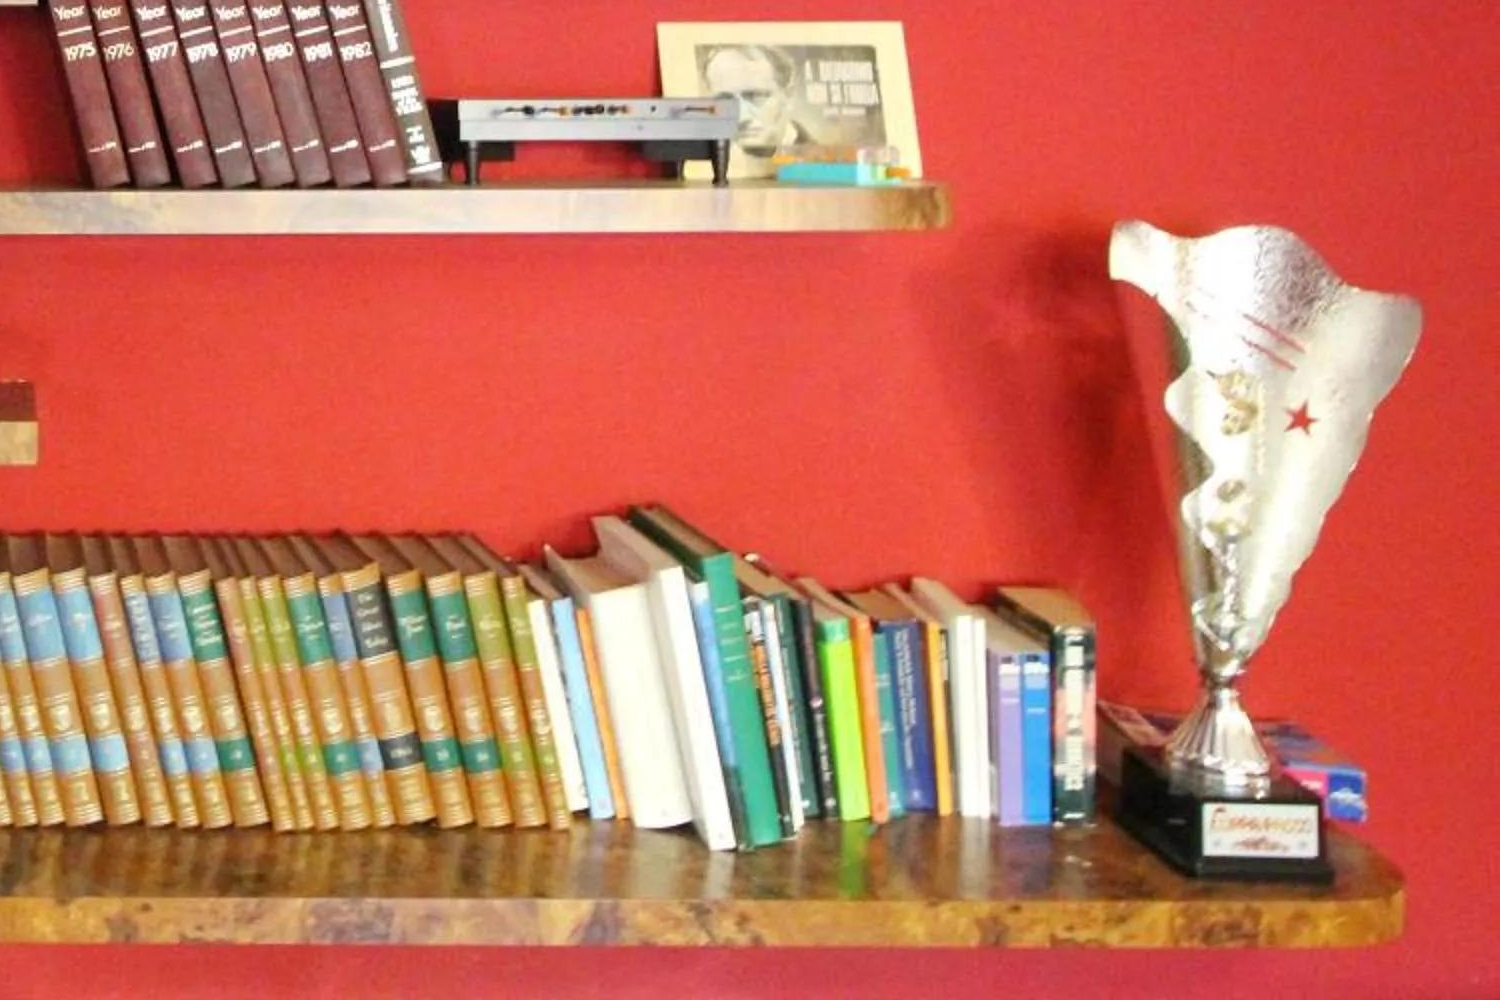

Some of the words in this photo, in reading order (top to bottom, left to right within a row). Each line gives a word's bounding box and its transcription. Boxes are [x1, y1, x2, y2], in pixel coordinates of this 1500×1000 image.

[54, 5, 85, 21] Year
[93, 5, 123, 20] Year
[137, 5, 167, 21] Year
[175, 5, 206, 23] Year
[215, 5, 246, 21] Year
[252, 4, 283, 20] Year
[291, 5, 321, 21] Year
[329, 4, 360, 20] Year
[65, 41, 97, 61] 1975
[103, 42, 135, 61] 1976
[147, 41, 178, 63] 1977
[186, 42, 219, 63] 1978
[225, 41, 257, 63] 1979
[262, 42, 294, 62] 1980
[303, 42, 333, 62] 1981
[340, 41, 373, 61] 1982
